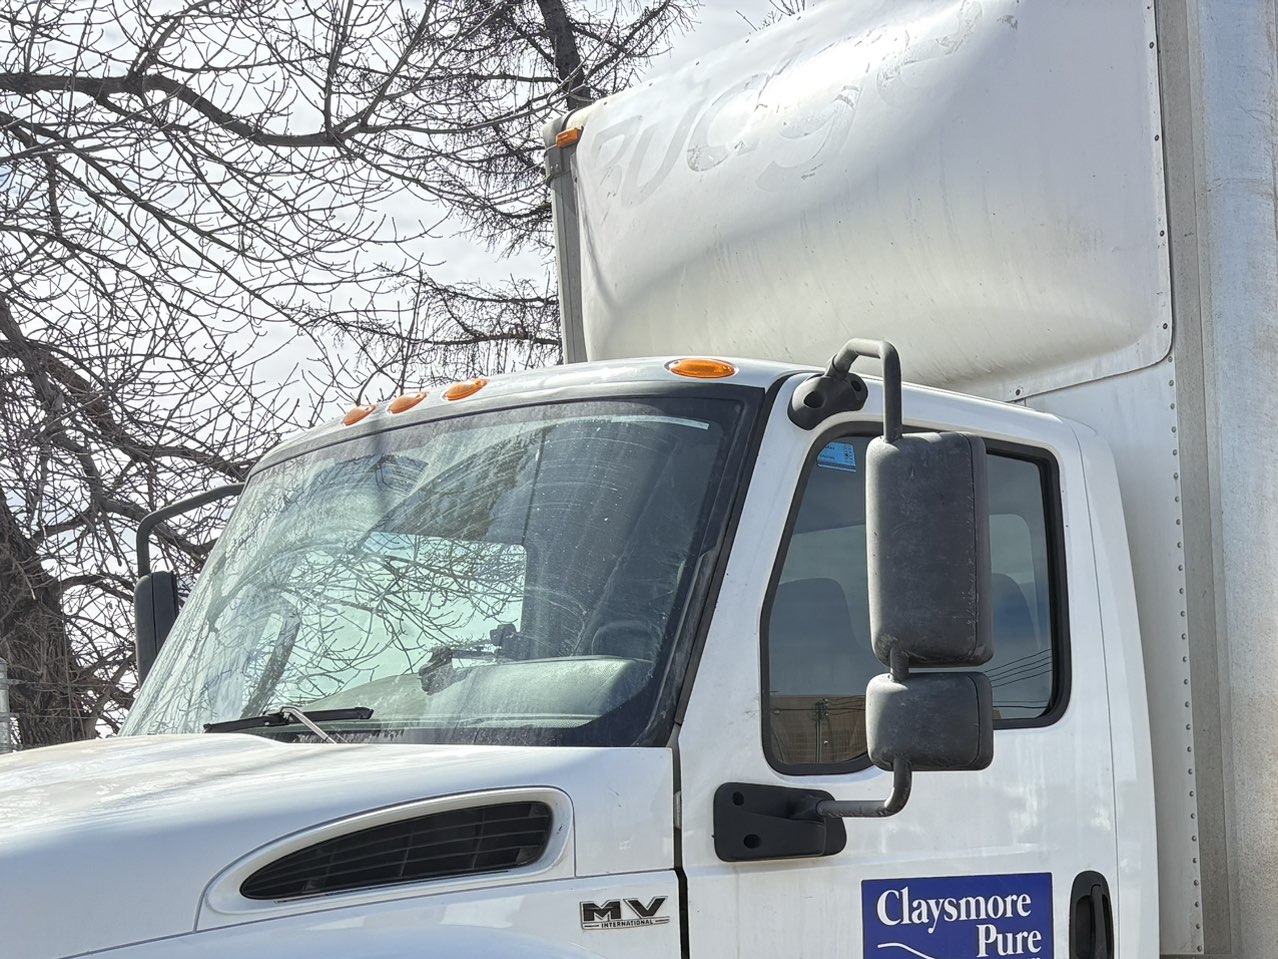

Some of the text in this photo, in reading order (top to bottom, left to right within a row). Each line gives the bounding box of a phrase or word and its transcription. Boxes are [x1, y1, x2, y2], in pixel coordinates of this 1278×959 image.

[580, 896, 668, 920] MV
[876, 886, 1031, 933] Claysmore
[601, 919, 653, 929] INTERNATIONAL
[976, 924, 1042, 957] Pure
